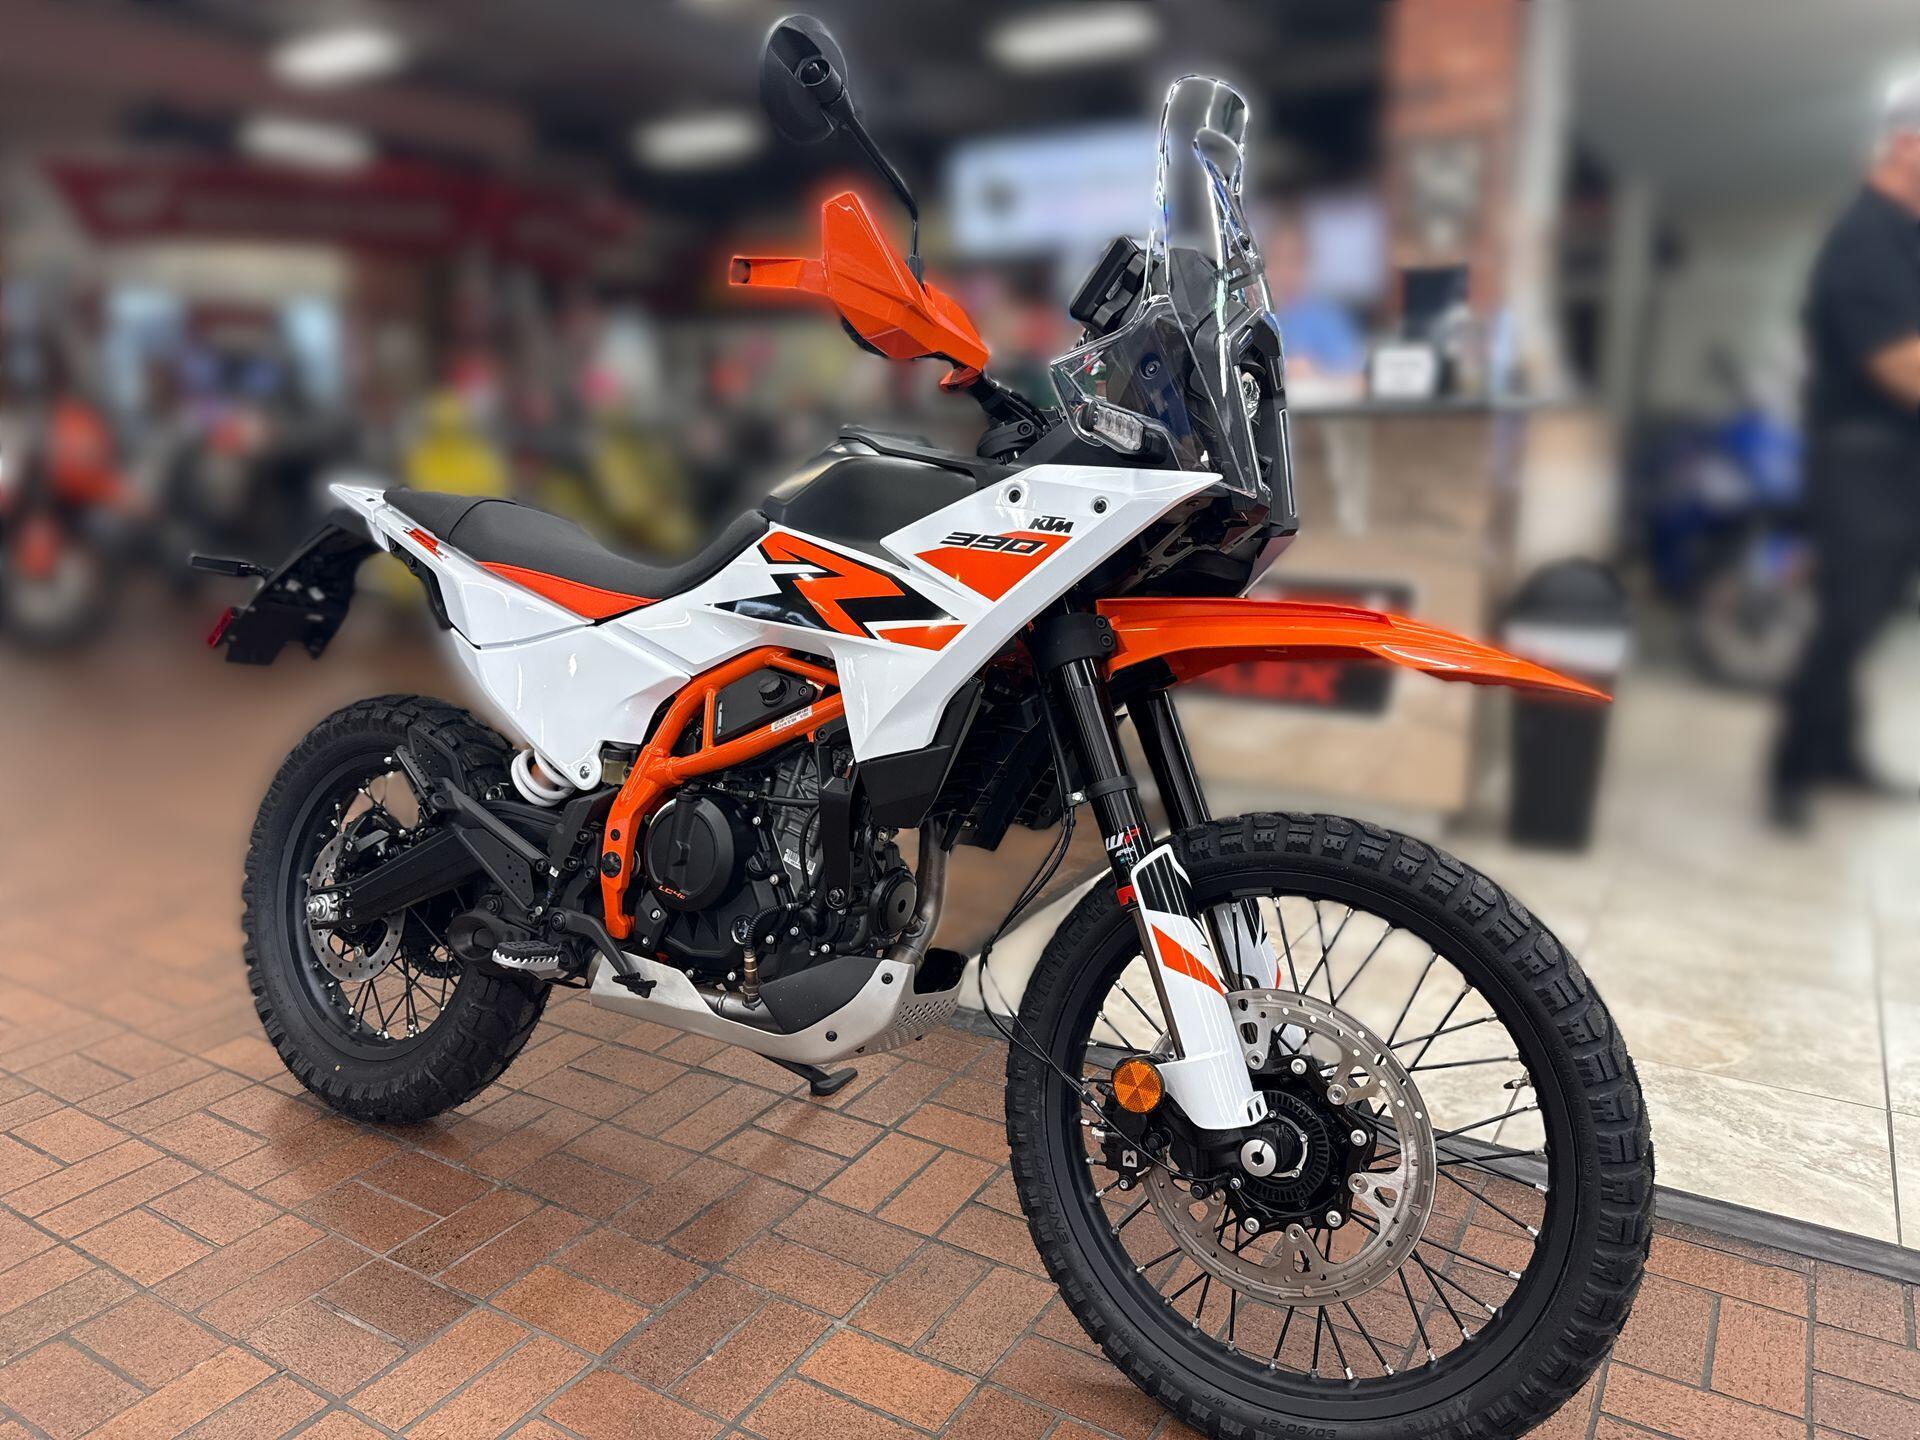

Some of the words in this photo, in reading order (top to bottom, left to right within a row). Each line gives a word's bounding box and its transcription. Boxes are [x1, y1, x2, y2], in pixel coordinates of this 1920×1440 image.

[1028, 515, 1075, 534] KTM
[939, 531, 1048, 555] 390
[1034, 1155, 1071, 1245] ENDURO
